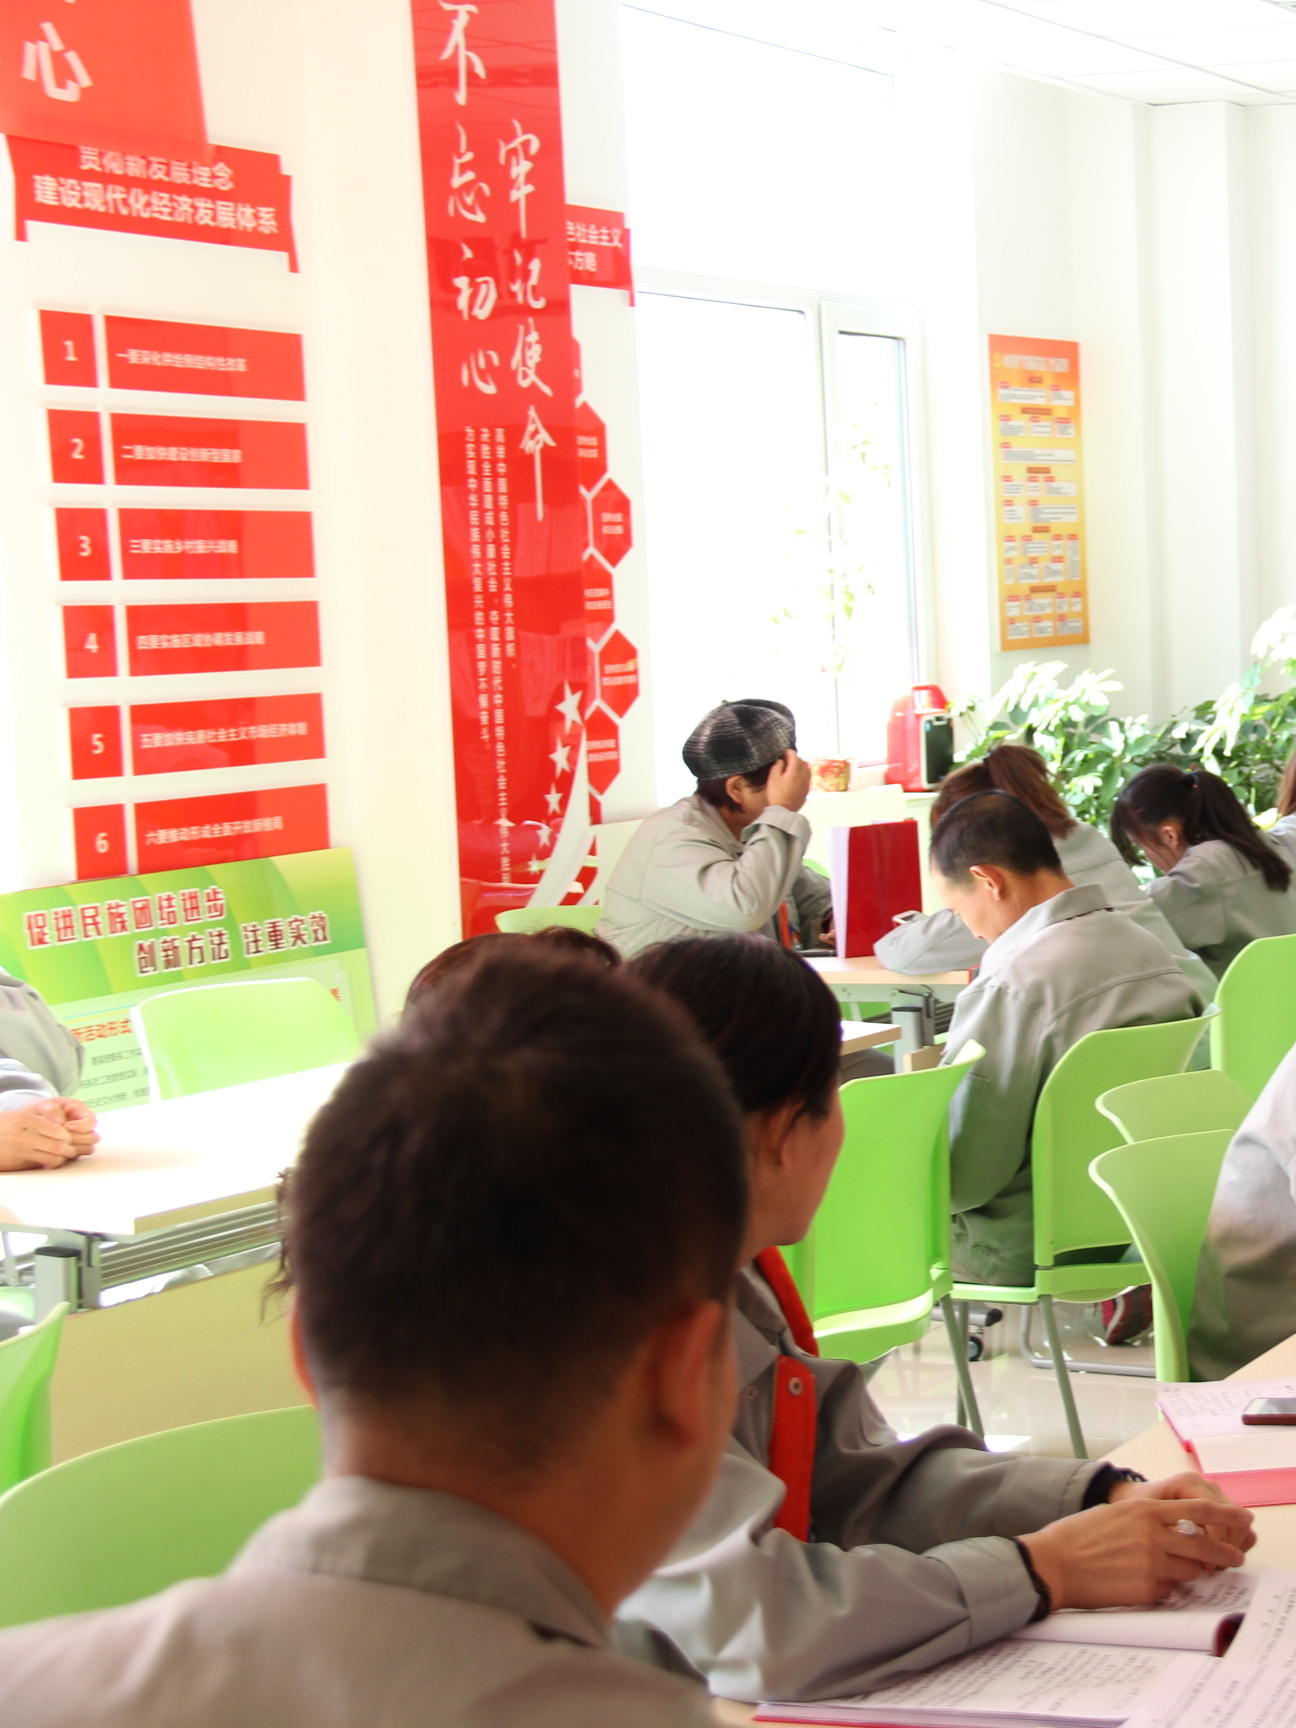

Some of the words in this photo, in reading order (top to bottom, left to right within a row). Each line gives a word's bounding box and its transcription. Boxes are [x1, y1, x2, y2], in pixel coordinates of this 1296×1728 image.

[33, 174, 279, 234] 建设现代化经济发展体系
[438, 0, 500, 396] 不忘初心
[498, 118, 558, 522] 牢记使命
[63, 340, 78, 361] 1
[71, 438, 85, 460] 2
[79, 535, 92, 557] 3
[85, 632, 99, 653] 4
[92, 733, 105, 754] 5
[95, 832, 109, 854] 6
[24, 886, 226, 950] 促进民族团结进步
[136, 928, 232, 977] 创新方法
[241, 910, 331, 958] 注重实效
